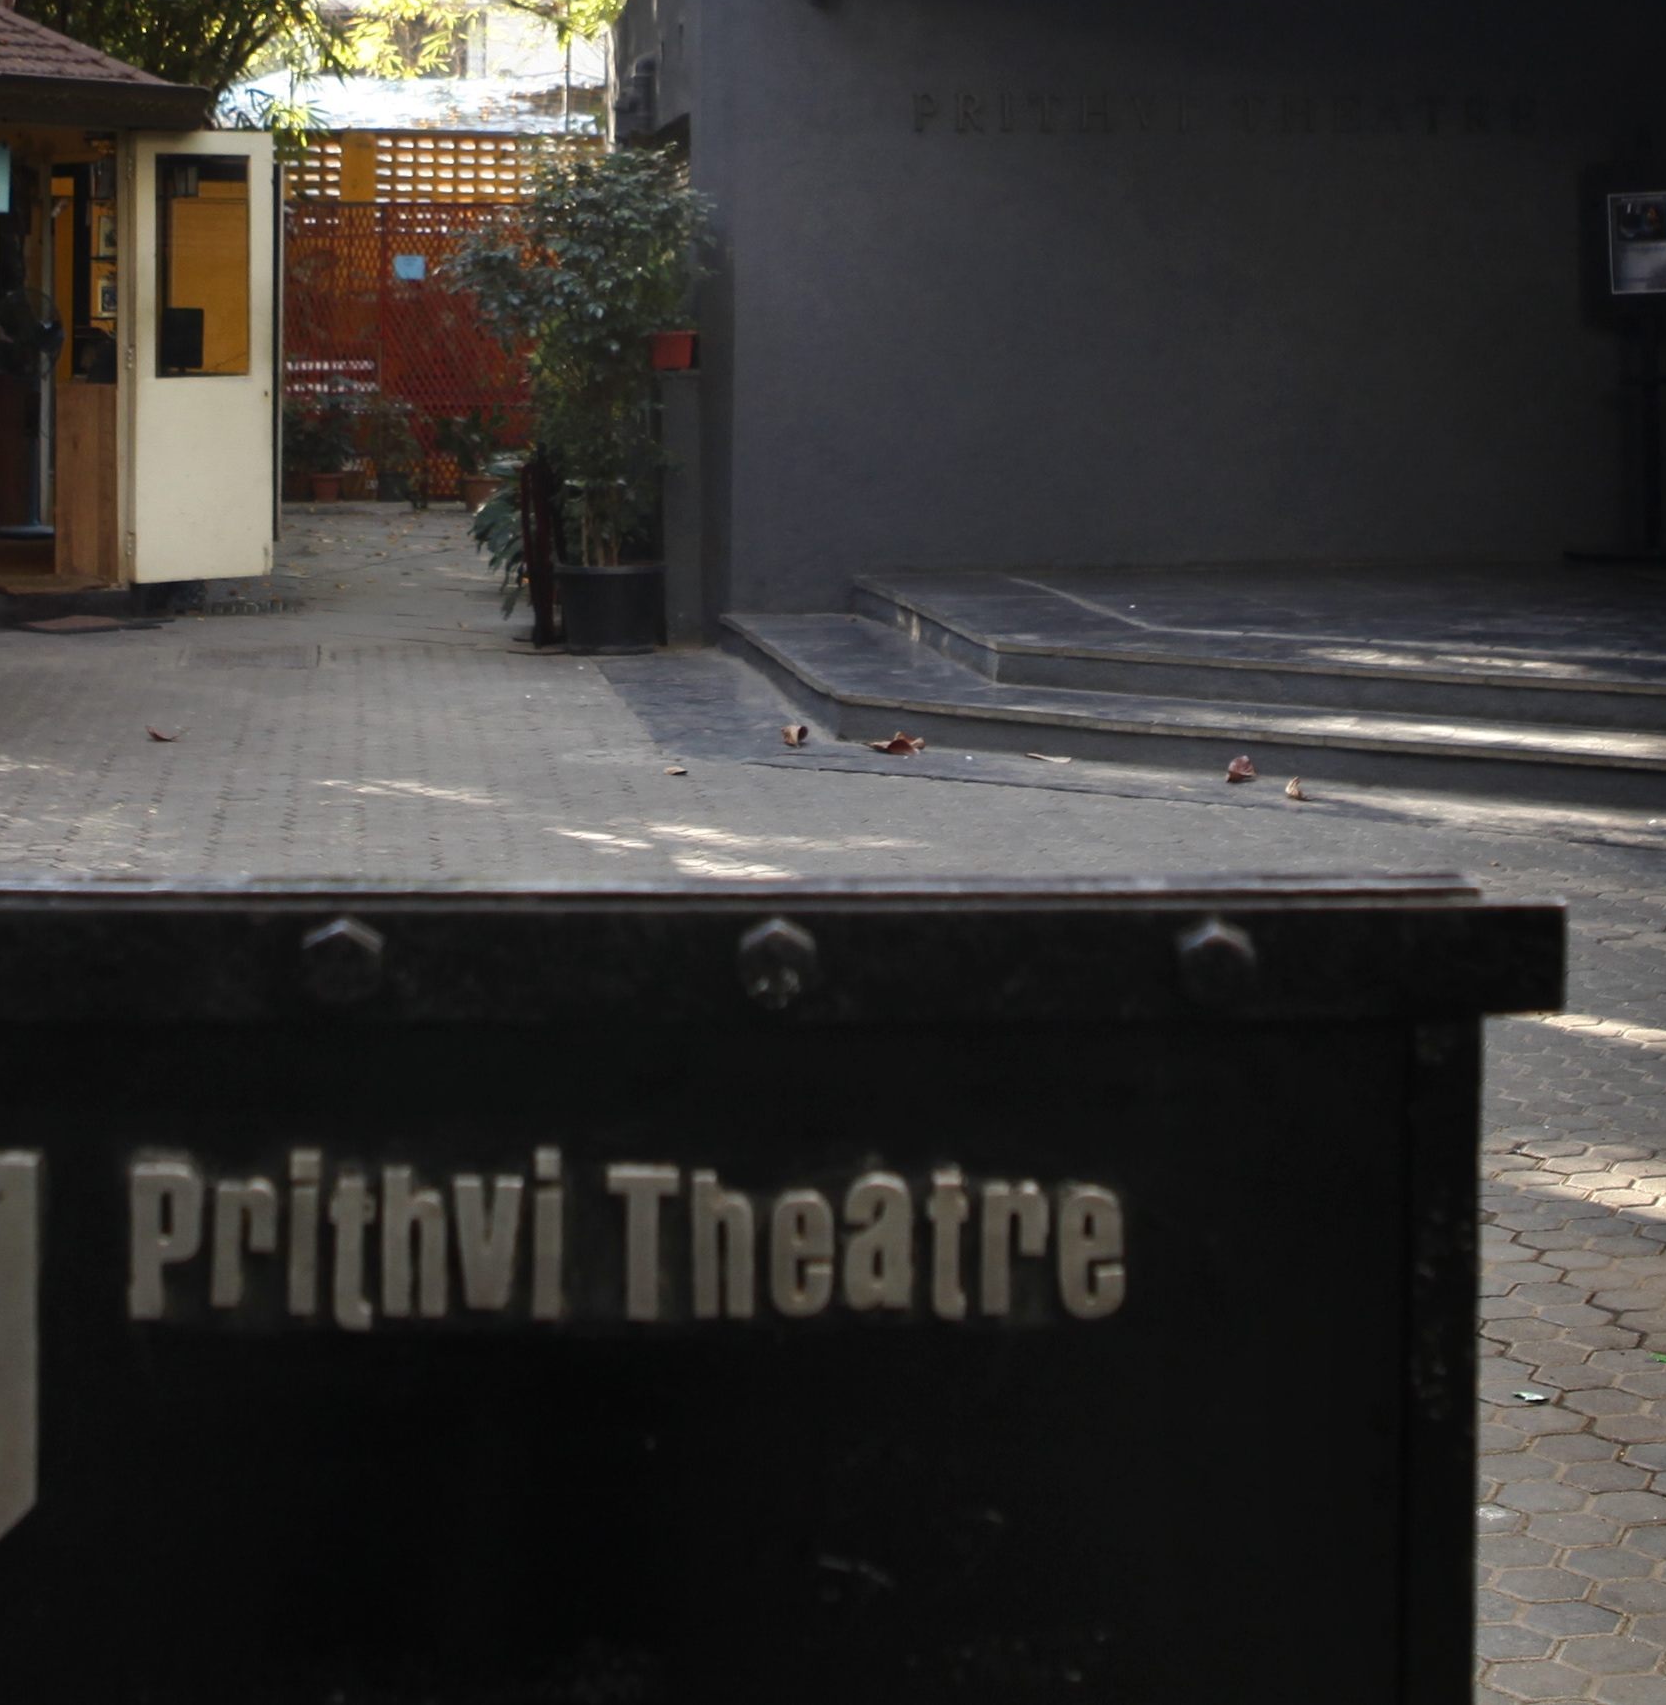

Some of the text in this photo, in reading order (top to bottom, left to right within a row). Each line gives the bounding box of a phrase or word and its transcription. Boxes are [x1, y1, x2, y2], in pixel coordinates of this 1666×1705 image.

[911, 92, 1191, 134] PRITHVI
[128, 1148, 1123, 1329] Prithvi Theatre
